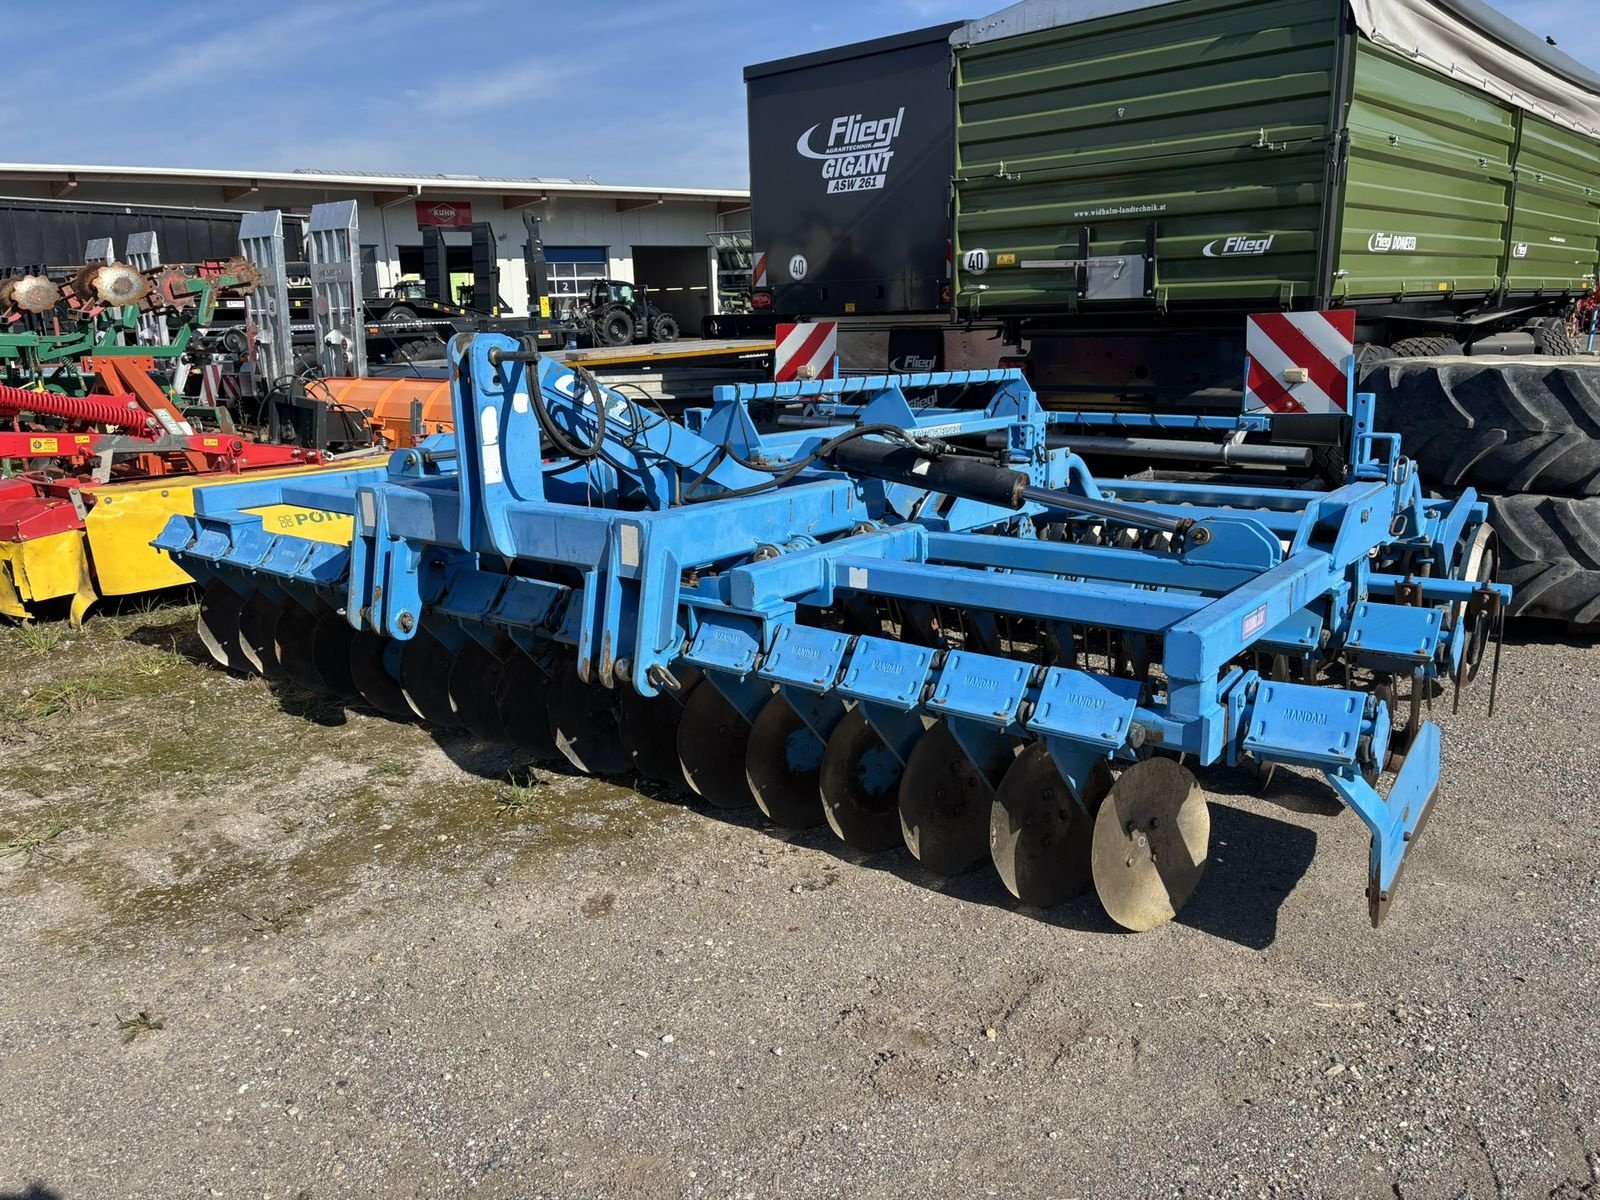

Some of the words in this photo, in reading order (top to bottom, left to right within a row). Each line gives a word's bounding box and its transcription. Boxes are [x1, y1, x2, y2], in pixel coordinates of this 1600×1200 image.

[828, 107, 905, 148] Fliegl
[825, 143, 873, 154] AGRARTECHNIK
[822, 151, 895, 179] GIGANT
[832, 179, 857, 192] ASW
[858, 176, 877, 189] 261
[433, 209, 456, 217] KUHN
[1074, 204, 1166, 217] www.widhalm-landtechnik.at
[1223, 234, 1275, 254] Fliegl
[793, 259, 804, 275] 40
[967, 252, 985, 272] 40
[562, 282, 569, 291] 2
[903, 355, 937, 371] Fliegl
[792, 645, 821, 659] MANDAM
[871, 659, 904, 676] MANDAM
[963, 674, 999, 691] MANDAM
[1065, 693, 1105, 711] MANDAM
[1283, 708, 1328, 726] MANDAM
